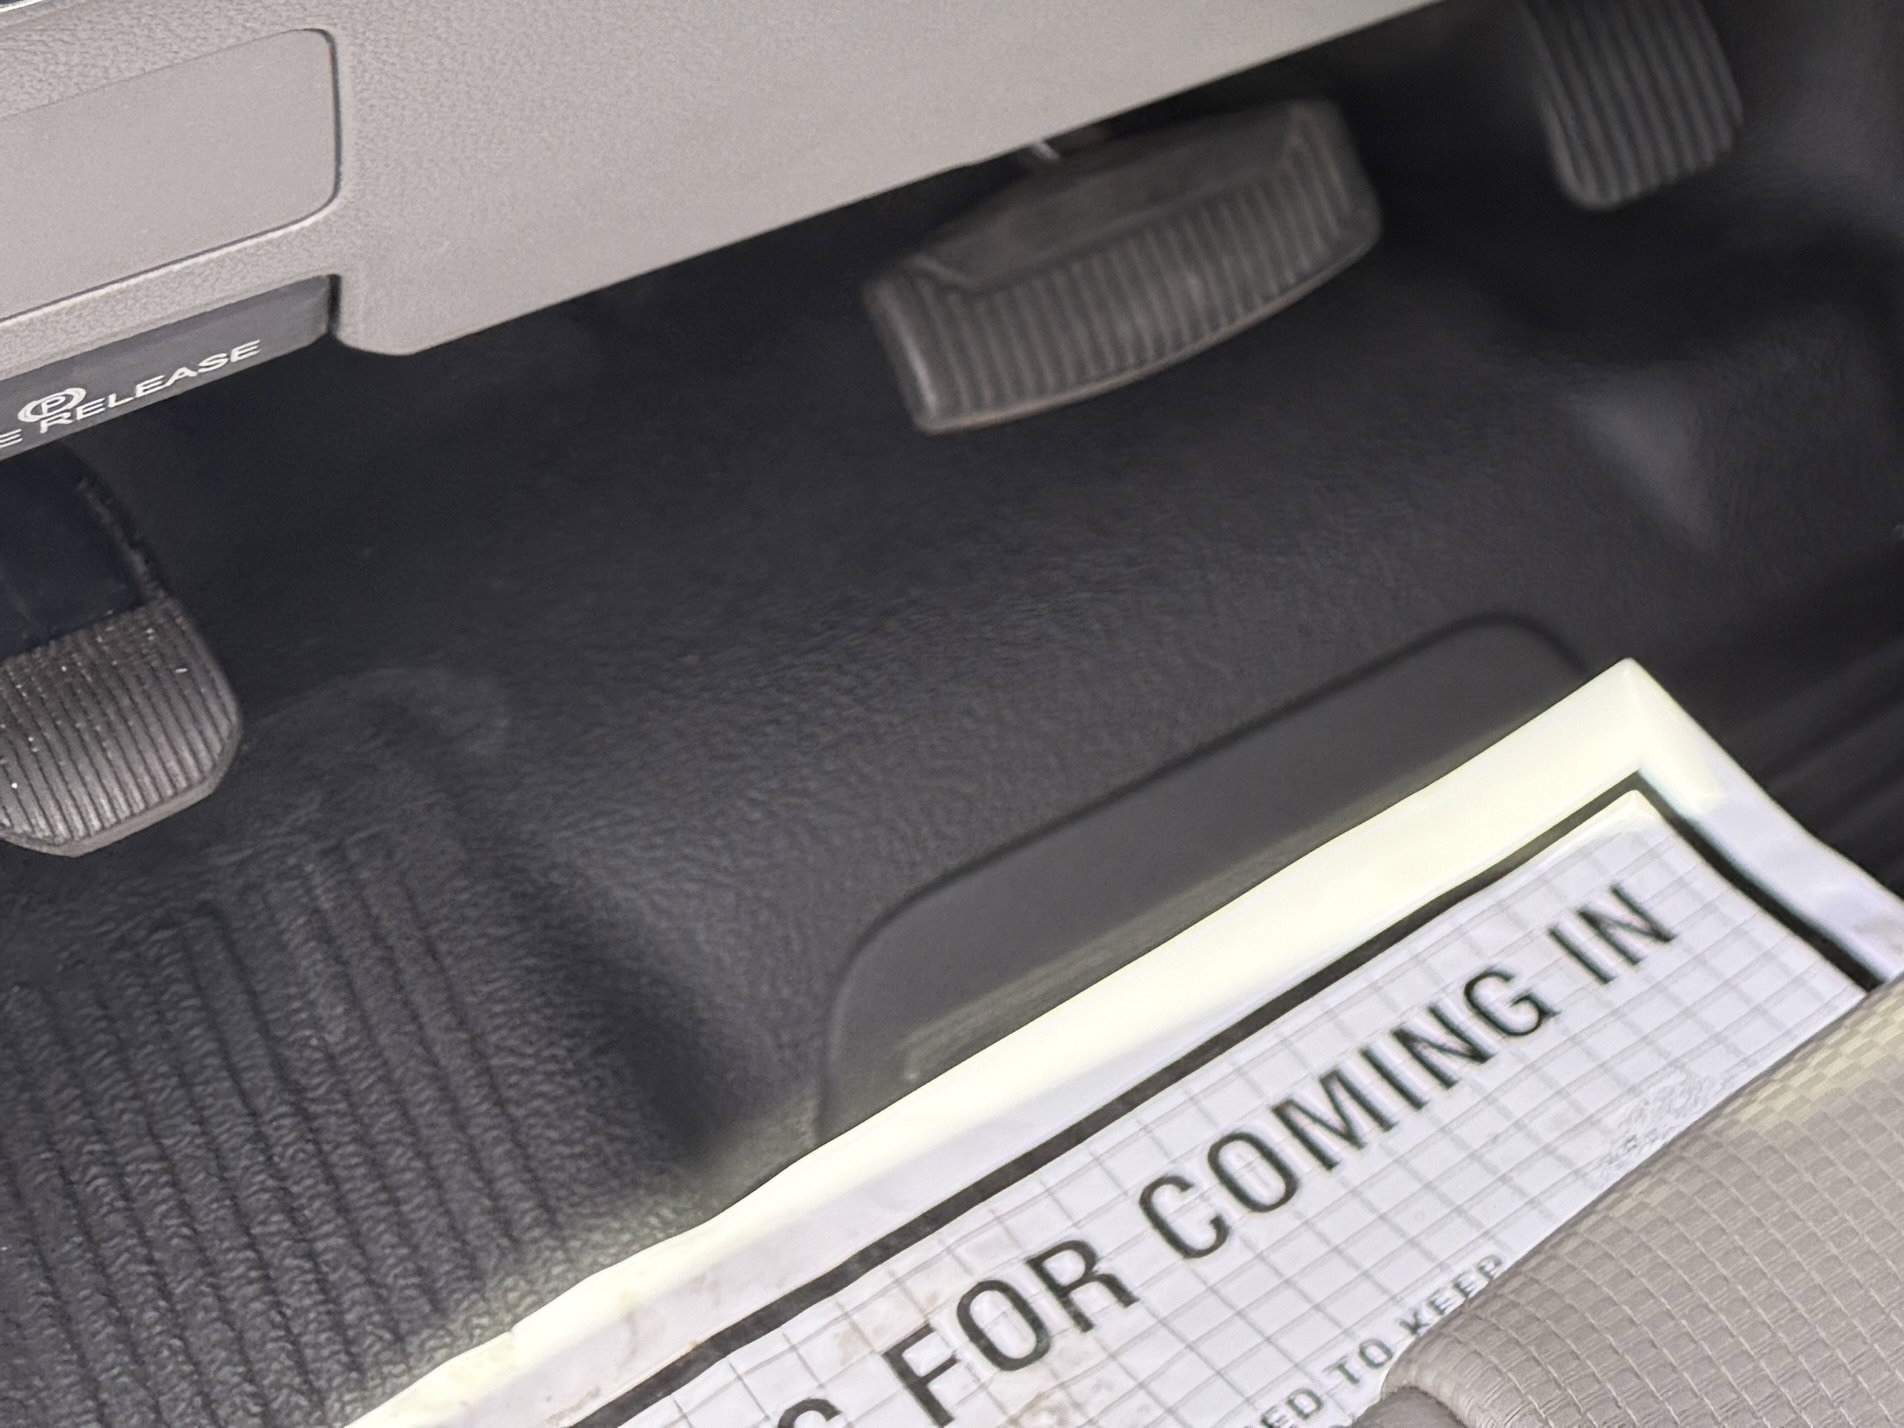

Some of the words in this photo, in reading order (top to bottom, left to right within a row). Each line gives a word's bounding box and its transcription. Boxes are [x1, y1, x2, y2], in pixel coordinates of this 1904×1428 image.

[40, 340, 261, 434] RELEASE
[881, 1237, 1140, 1428] FOR
[1138, 966, 1561, 1260] COMING
[1548, 882, 1678, 985] IN
[1322, 1337, 1394, 1385] TO
[1396, 1253, 1503, 1337] KEEP
